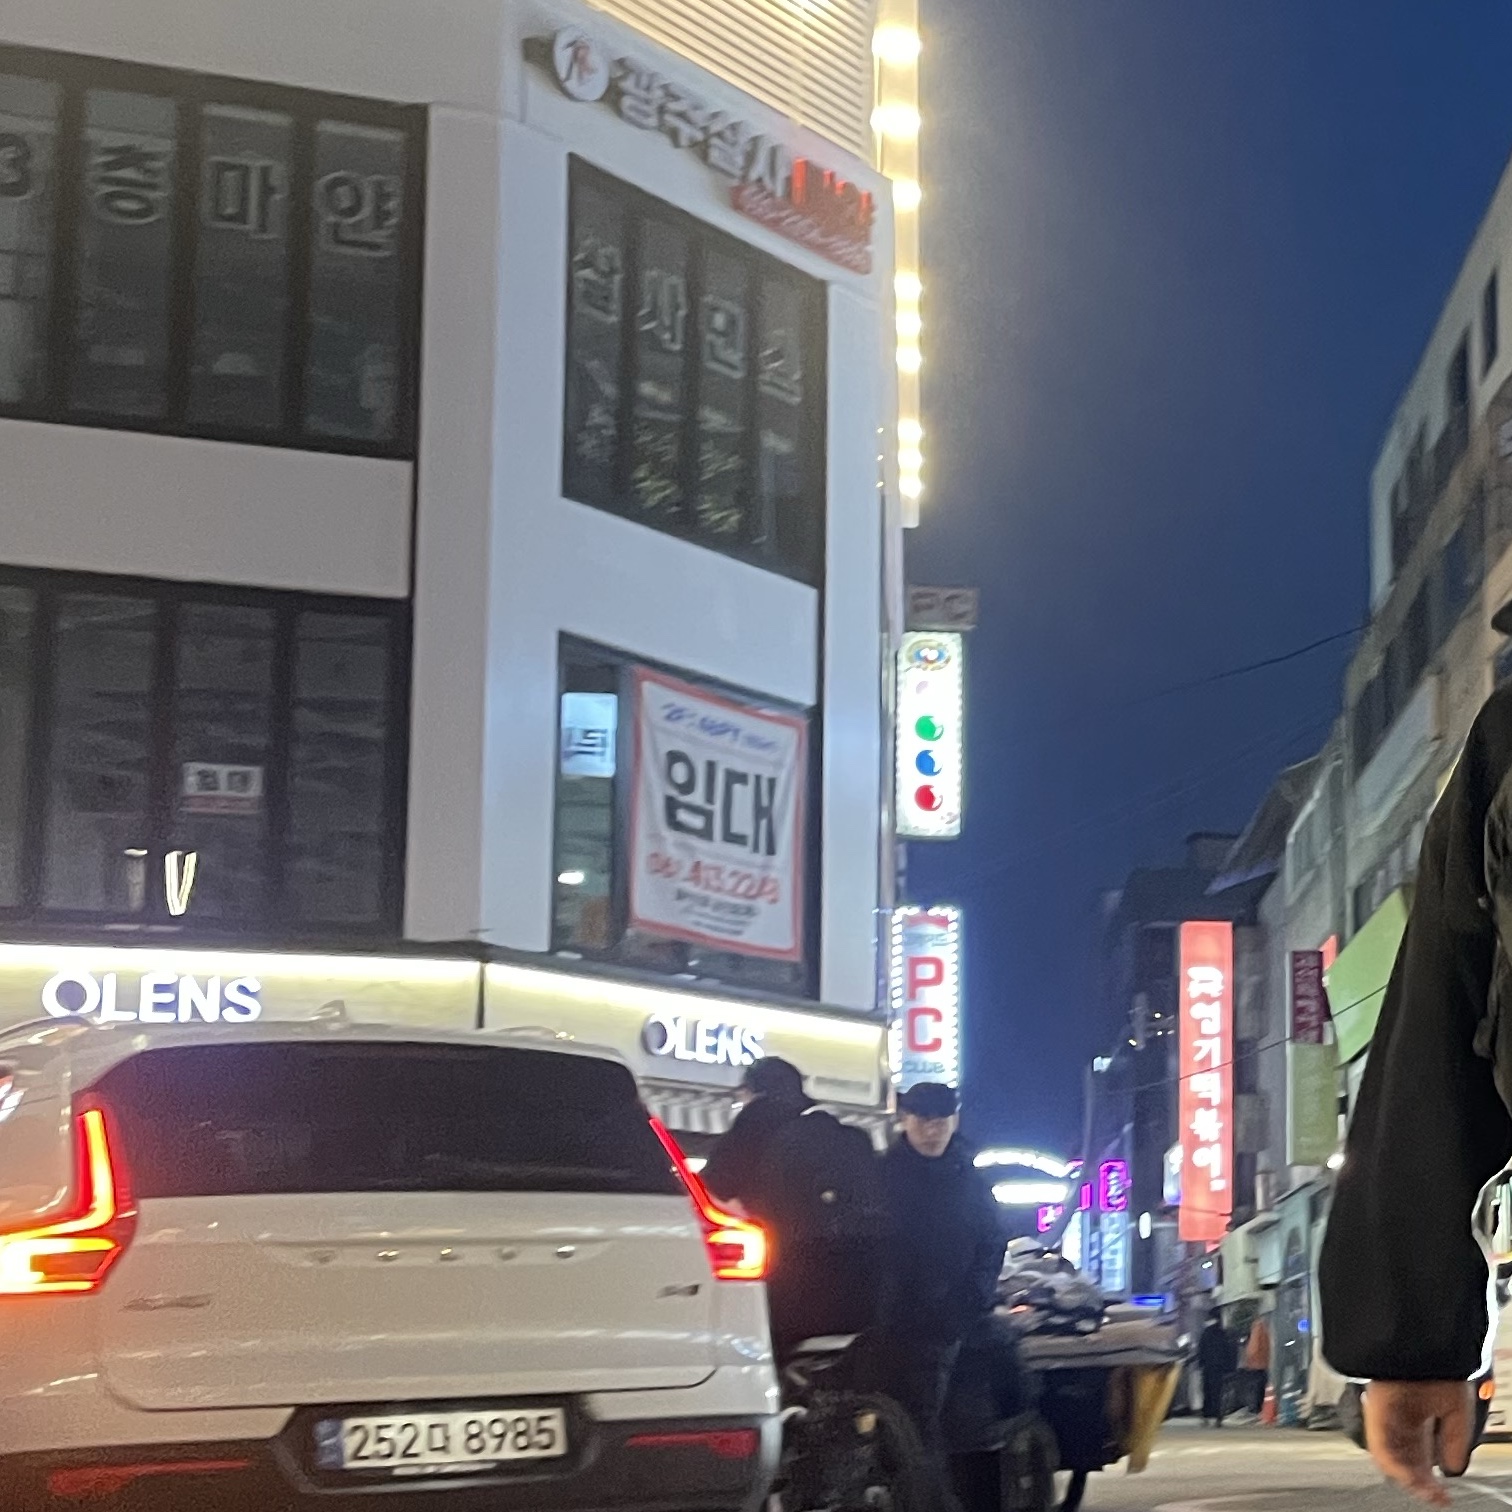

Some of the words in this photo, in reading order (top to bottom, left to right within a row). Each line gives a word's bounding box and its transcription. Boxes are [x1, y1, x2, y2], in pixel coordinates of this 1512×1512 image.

[665, 750, 776, 855] 임대
[42, 971, 262, 1025] OLENS
[643, 1012, 766, 1066] OLENS
[464, 1414, 557, 1455] 8985
